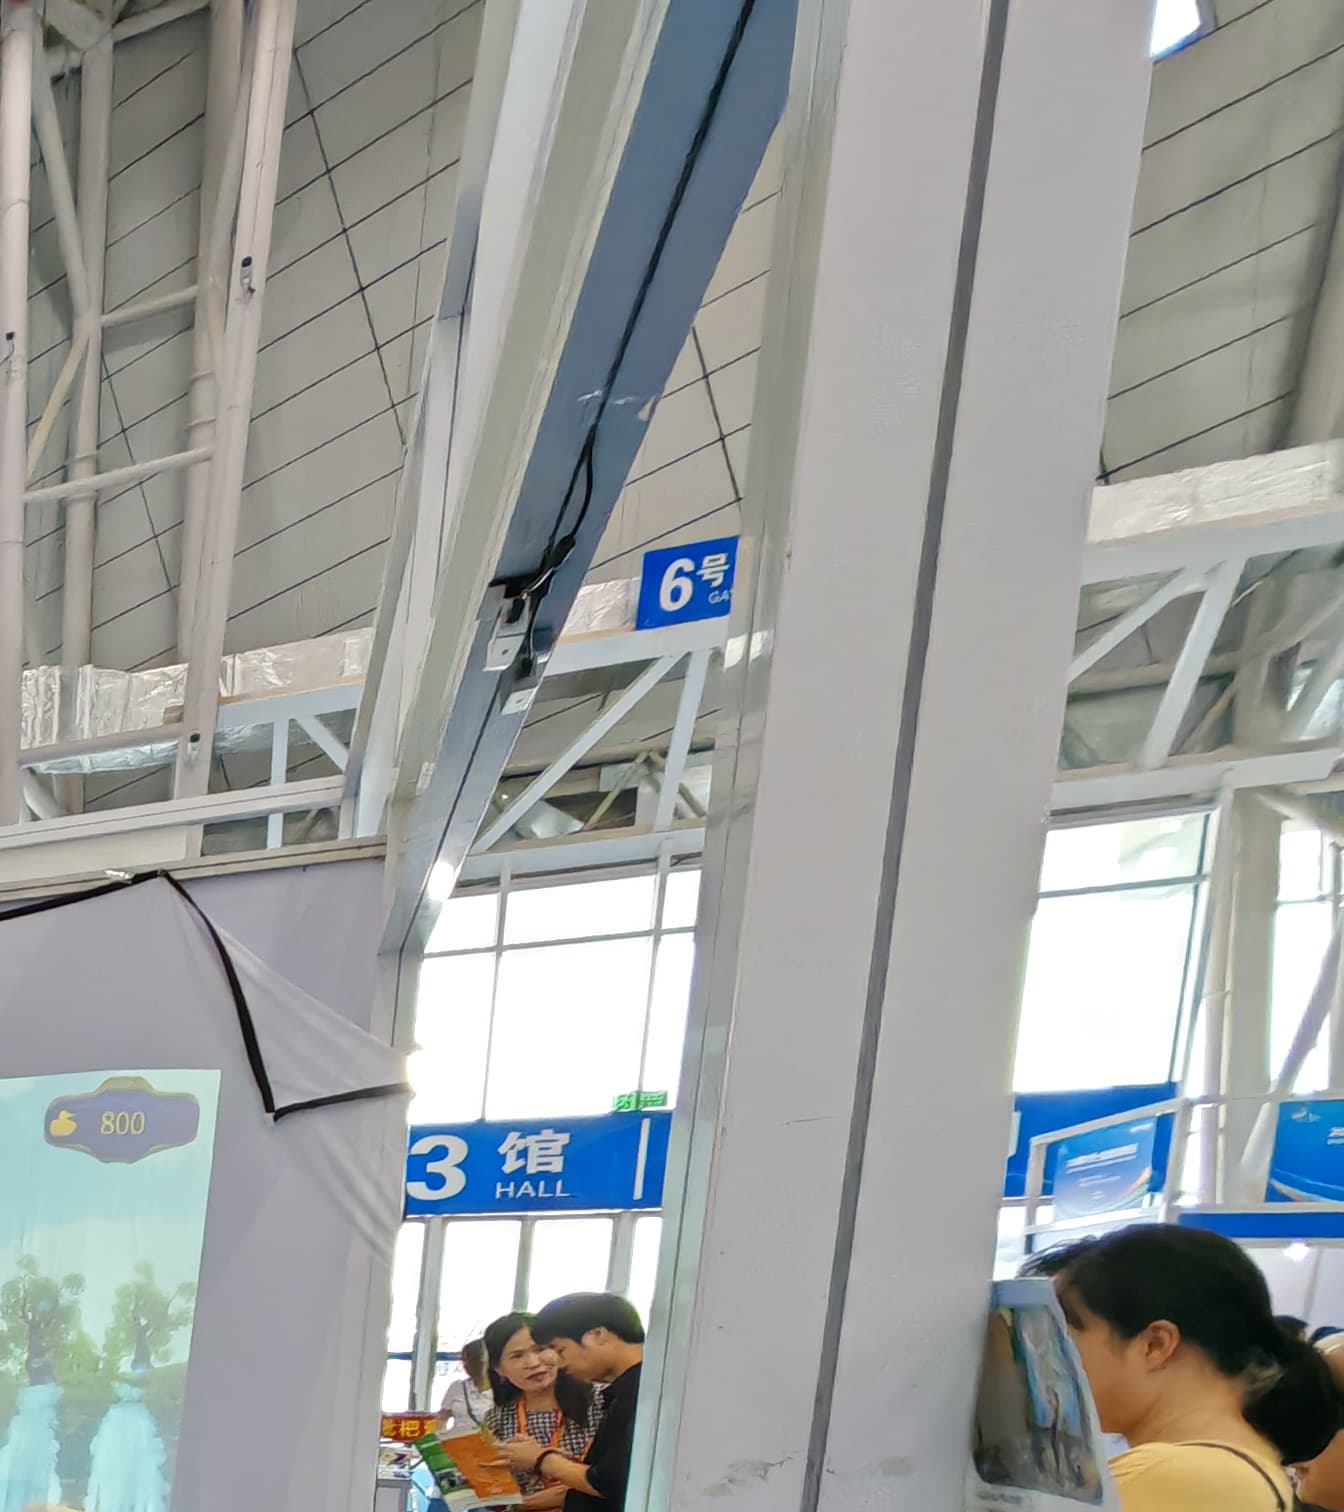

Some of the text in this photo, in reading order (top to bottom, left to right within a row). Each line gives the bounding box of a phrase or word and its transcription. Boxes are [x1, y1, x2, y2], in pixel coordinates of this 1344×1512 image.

[708, 589, 733, 605] GA
[99, 1109, 146, 1136] 800
[406, 1128, 571, 1201] 3 馆
[495, 1180, 572, 1200] HALL
